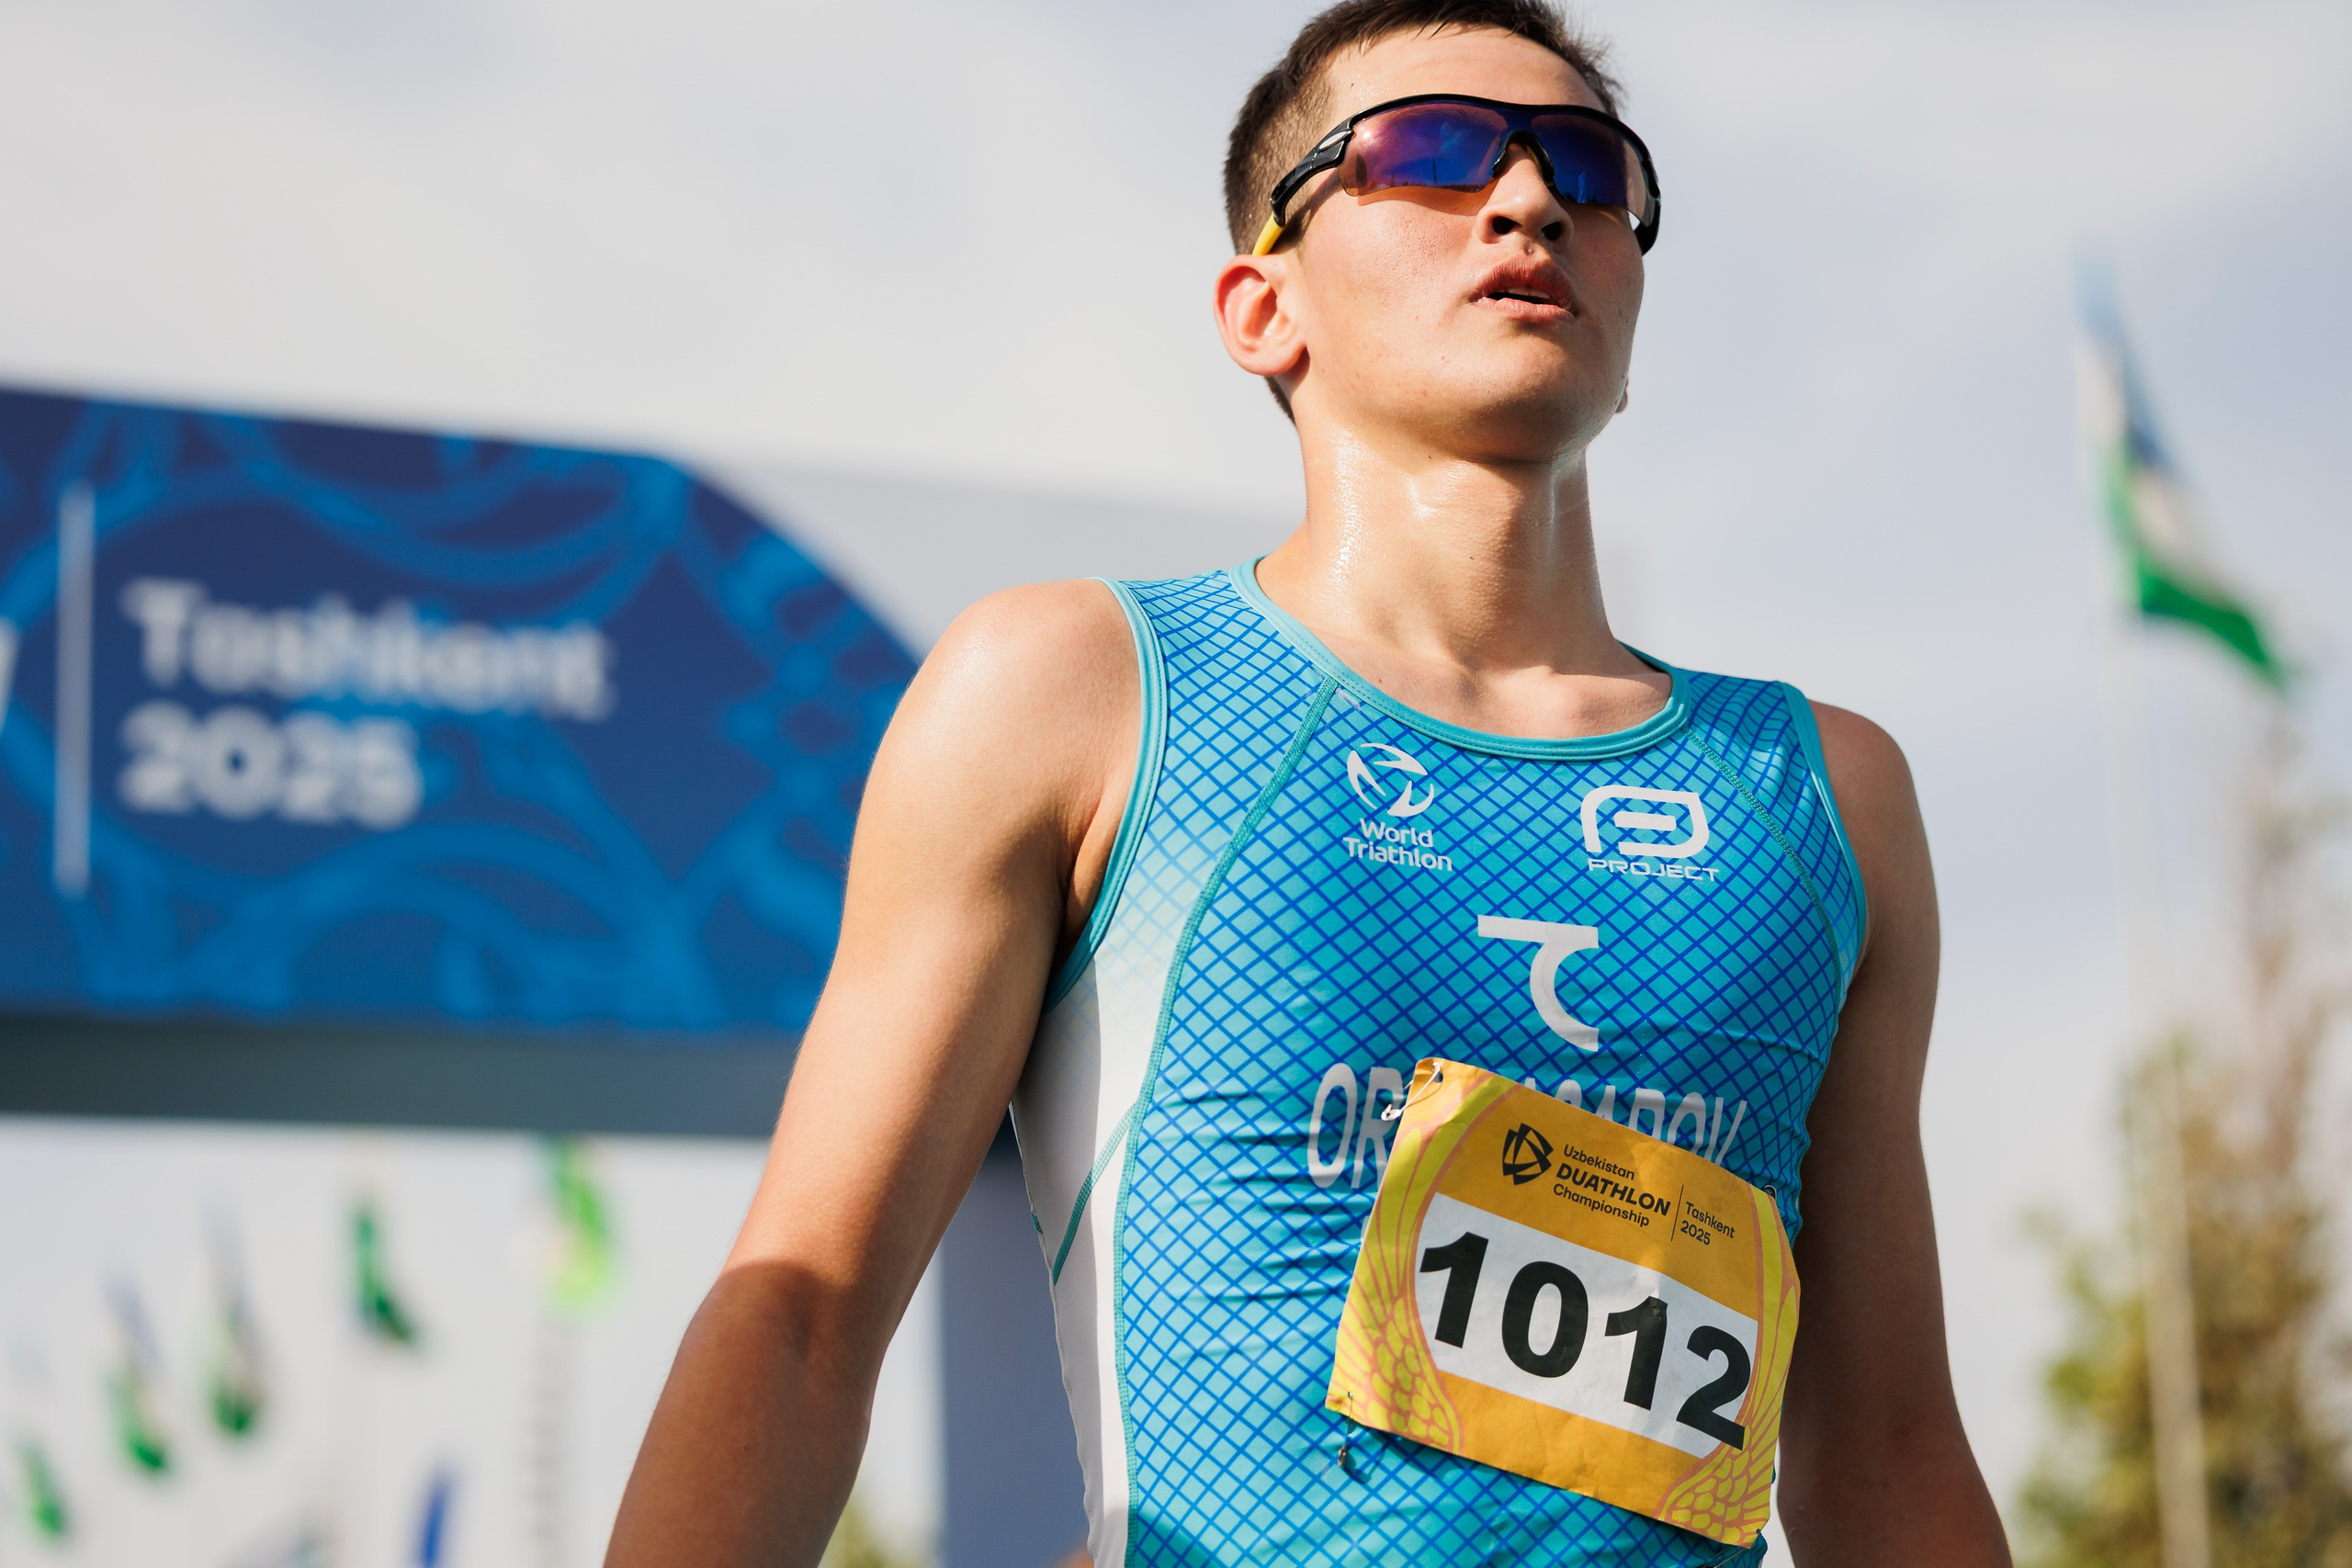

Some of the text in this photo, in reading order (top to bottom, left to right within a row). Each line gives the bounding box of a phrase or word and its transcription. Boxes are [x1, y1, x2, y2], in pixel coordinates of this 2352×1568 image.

[120, 579, 613, 721] Tashkent
[120, 702, 423, 829] 2025
[1360, 818, 1434, 848] World
[1342, 837, 1453, 872] Triathlon
[1588, 858, 1720, 882] PROJECT
[1563, 1144, 1635, 1180] Uzbekistan
[1553, 1183, 1650, 1227] Championship
[1555, 1162, 1671, 1216] DUATHLON
[1679, 1220, 1711, 1246] 2025
[1685, 1201, 1736, 1239] Tashkent
[1419, 1231, 1752, 1451] 1012
